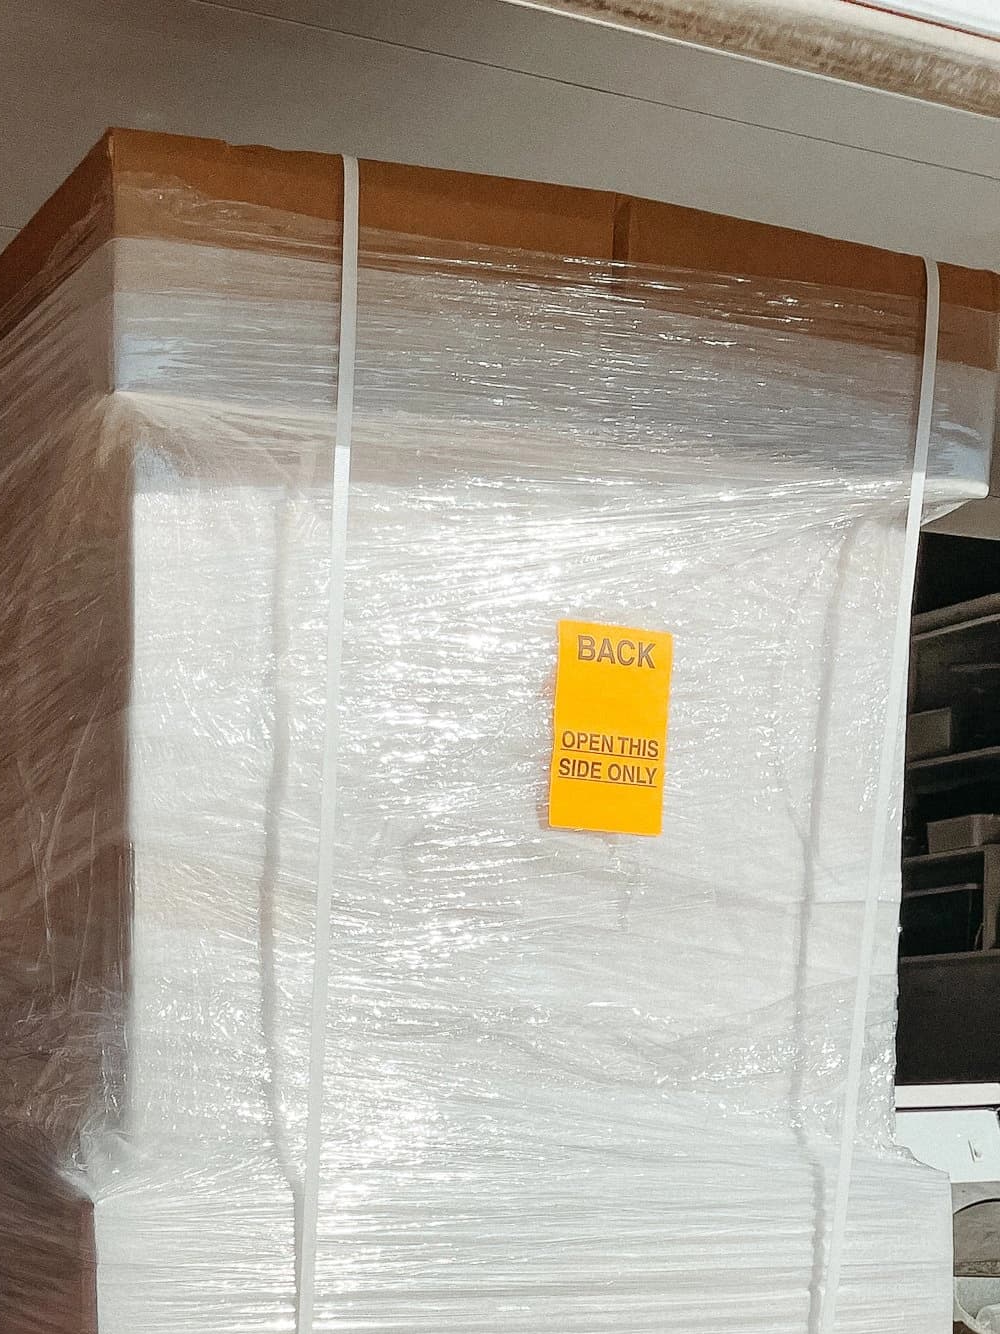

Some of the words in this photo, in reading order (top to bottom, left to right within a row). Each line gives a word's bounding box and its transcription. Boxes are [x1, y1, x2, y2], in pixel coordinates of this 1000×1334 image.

[577, 634, 656, 669] BACK
[561, 730, 614, 753] OPEN
[617, 736, 660, 758] THIS
[558, 757, 602, 780] SIDE
[607, 763, 658, 785] ONLY
